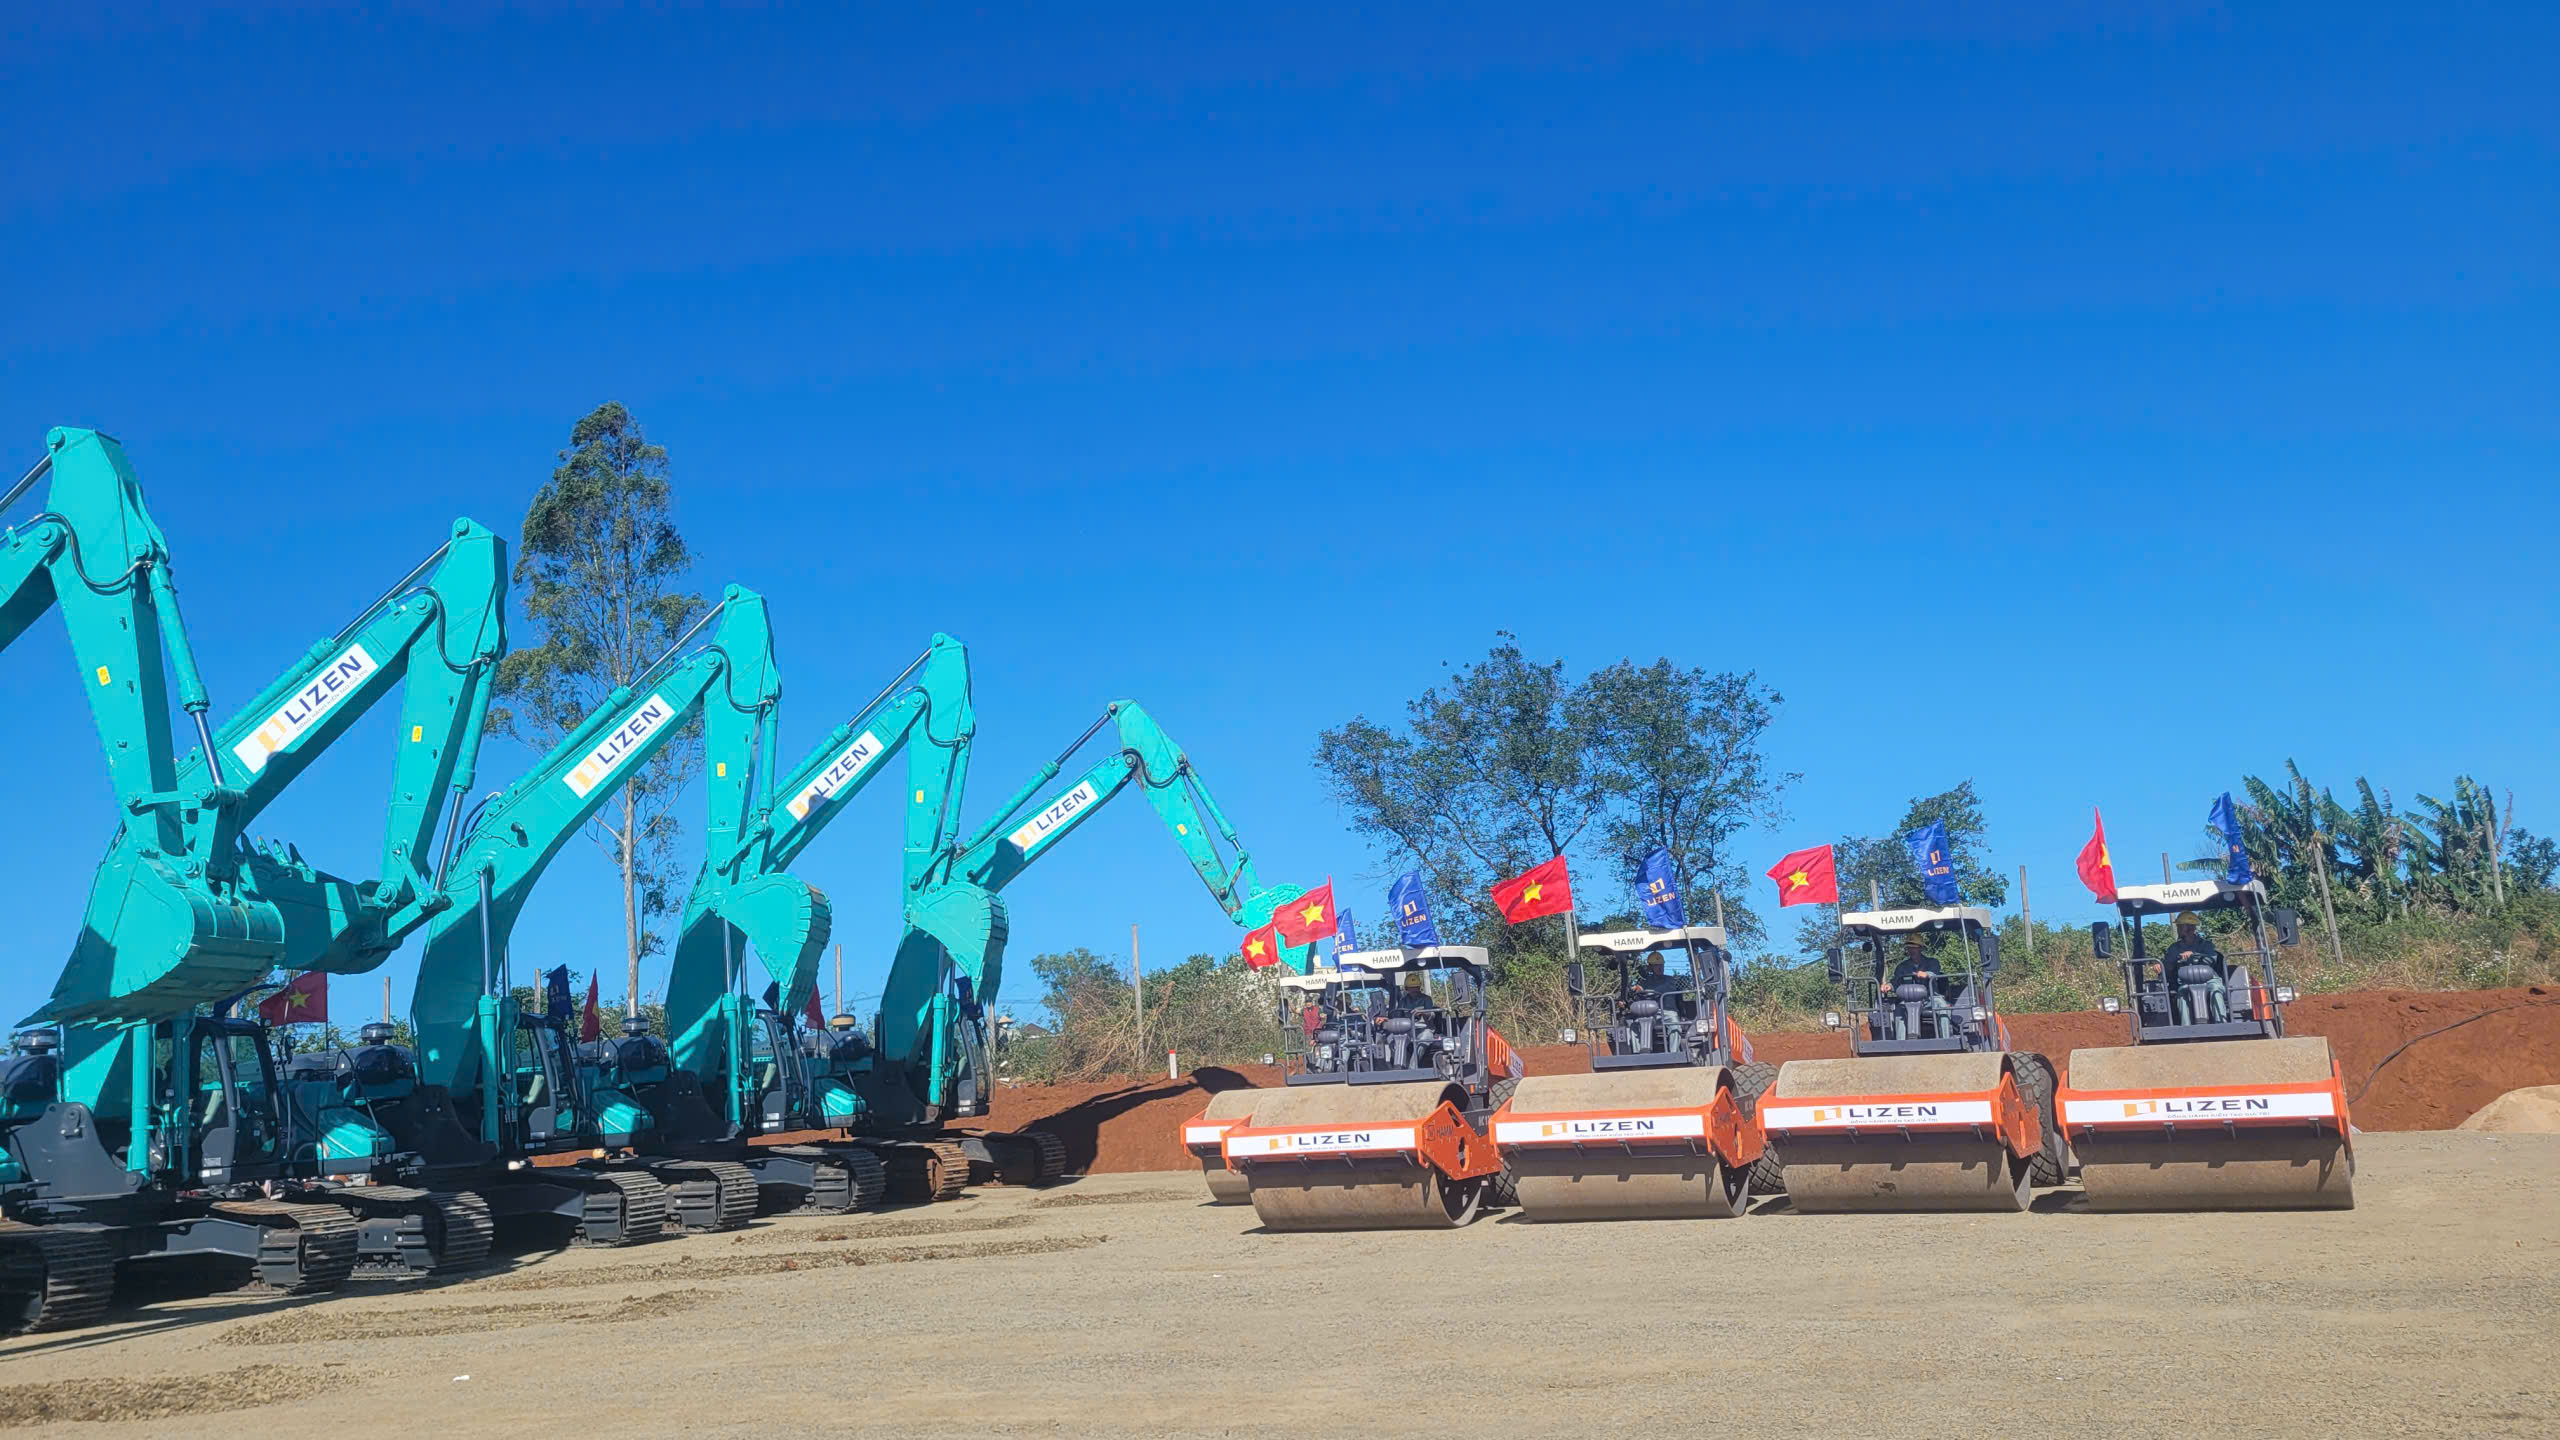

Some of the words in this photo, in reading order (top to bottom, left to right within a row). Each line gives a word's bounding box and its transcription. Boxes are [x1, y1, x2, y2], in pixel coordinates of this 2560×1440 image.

[284, 655, 362, 724] LIZEN
[597, 704, 662, 765] LIZEN
[814, 743, 869, 796] LIZEN
[1036, 789, 1087, 830] LIZEN
[1647, 892, 1676, 906] LIZEN
[2162, 888, 2200, 899] HAMM
[1401, 914, 1426, 928] LIZEN
[1881, 915, 1914, 924] HAMM
[1614, 937, 1644, 946] HAMM
[1372, 955, 1400, 965] HAMM
[1305, 977, 1327, 986] HAMM
[1849, 1106, 1936, 1118] LIZEN
[2165, 1099, 2269, 1112] LIZEN
[1574, 1120, 1654, 1132] LIZEN
[1298, 1133, 1370, 1146] LIZEN
